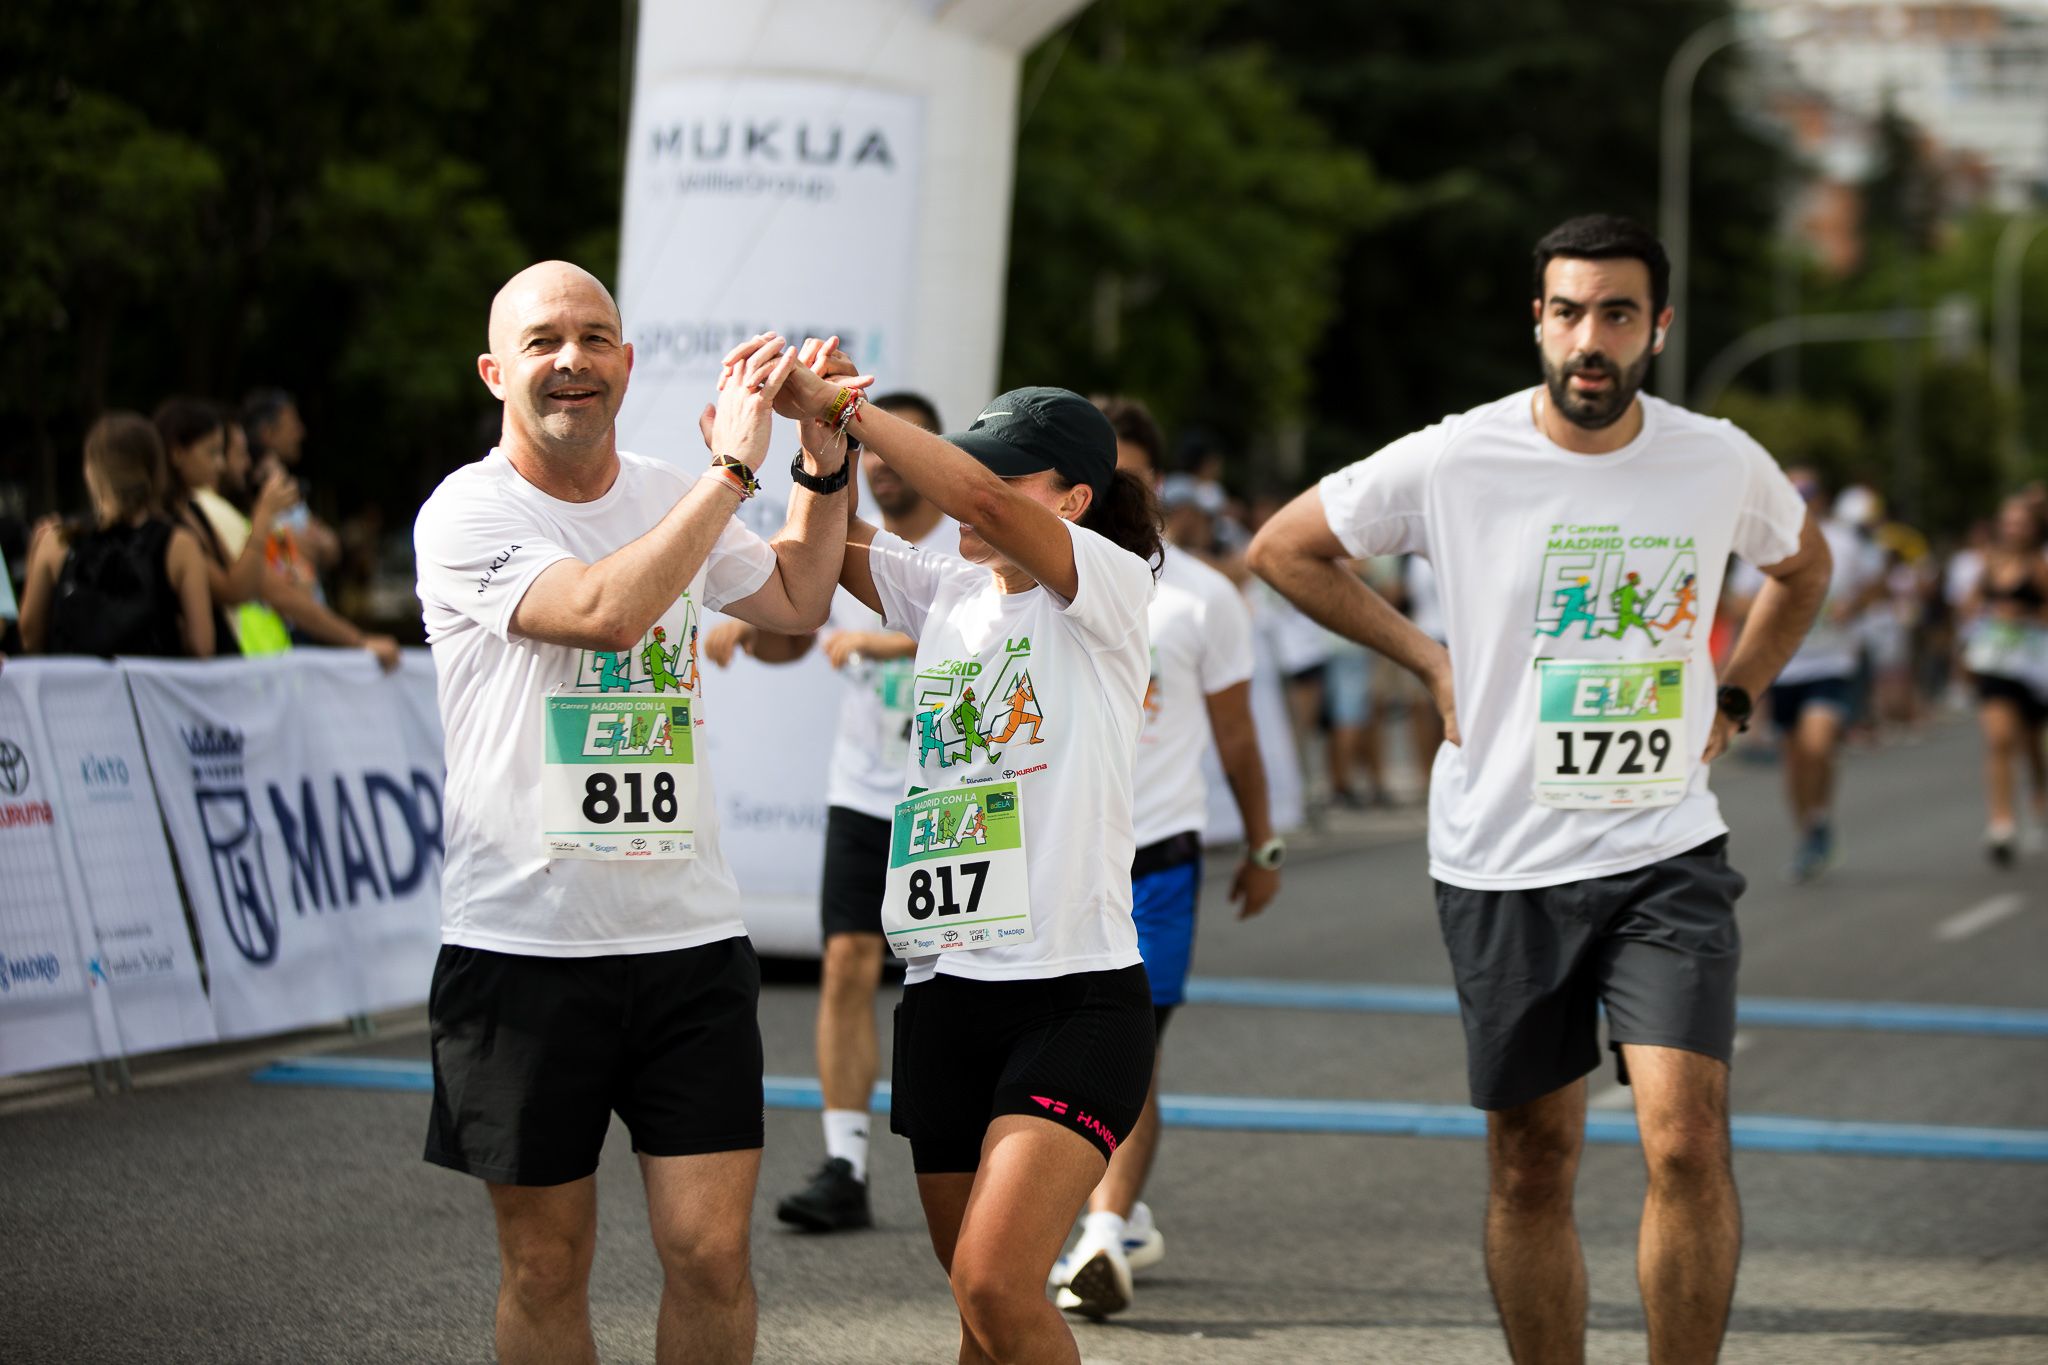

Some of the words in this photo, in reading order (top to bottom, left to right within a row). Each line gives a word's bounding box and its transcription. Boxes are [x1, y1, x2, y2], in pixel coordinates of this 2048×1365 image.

[650, 119, 895, 172] MUKUA
[1547, 537, 1624, 550] MADRID
[1629, 536, 1669, 548] CON
[1675, 537, 1695, 548] LA
[1568, 524, 1619, 535] Carrera
[478, 545, 522, 597] MUKUA
[1006, 637, 1031, 652] LA
[560, 702, 588, 710] Carrera
[590, 702, 633, 711] MADRID
[634, 702, 653, 711] CON
[654, 702, 666, 711] LA
[1572, 676, 1659, 717] ELA
[582, 712, 673, 756] ELA
[1556, 729, 1671, 775] 1729
[582, 771, 678, 824] 818
[914, 797, 940, 812] MADRID
[942, 794, 962, 805] CON
[965, 792, 977, 802] LA
[908, 803, 986, 856] ELA
[907, 861, 991, 921] 817
[1004, 928, 1025, 936] MADRID
[9, 953, 60, 984] MADRID
